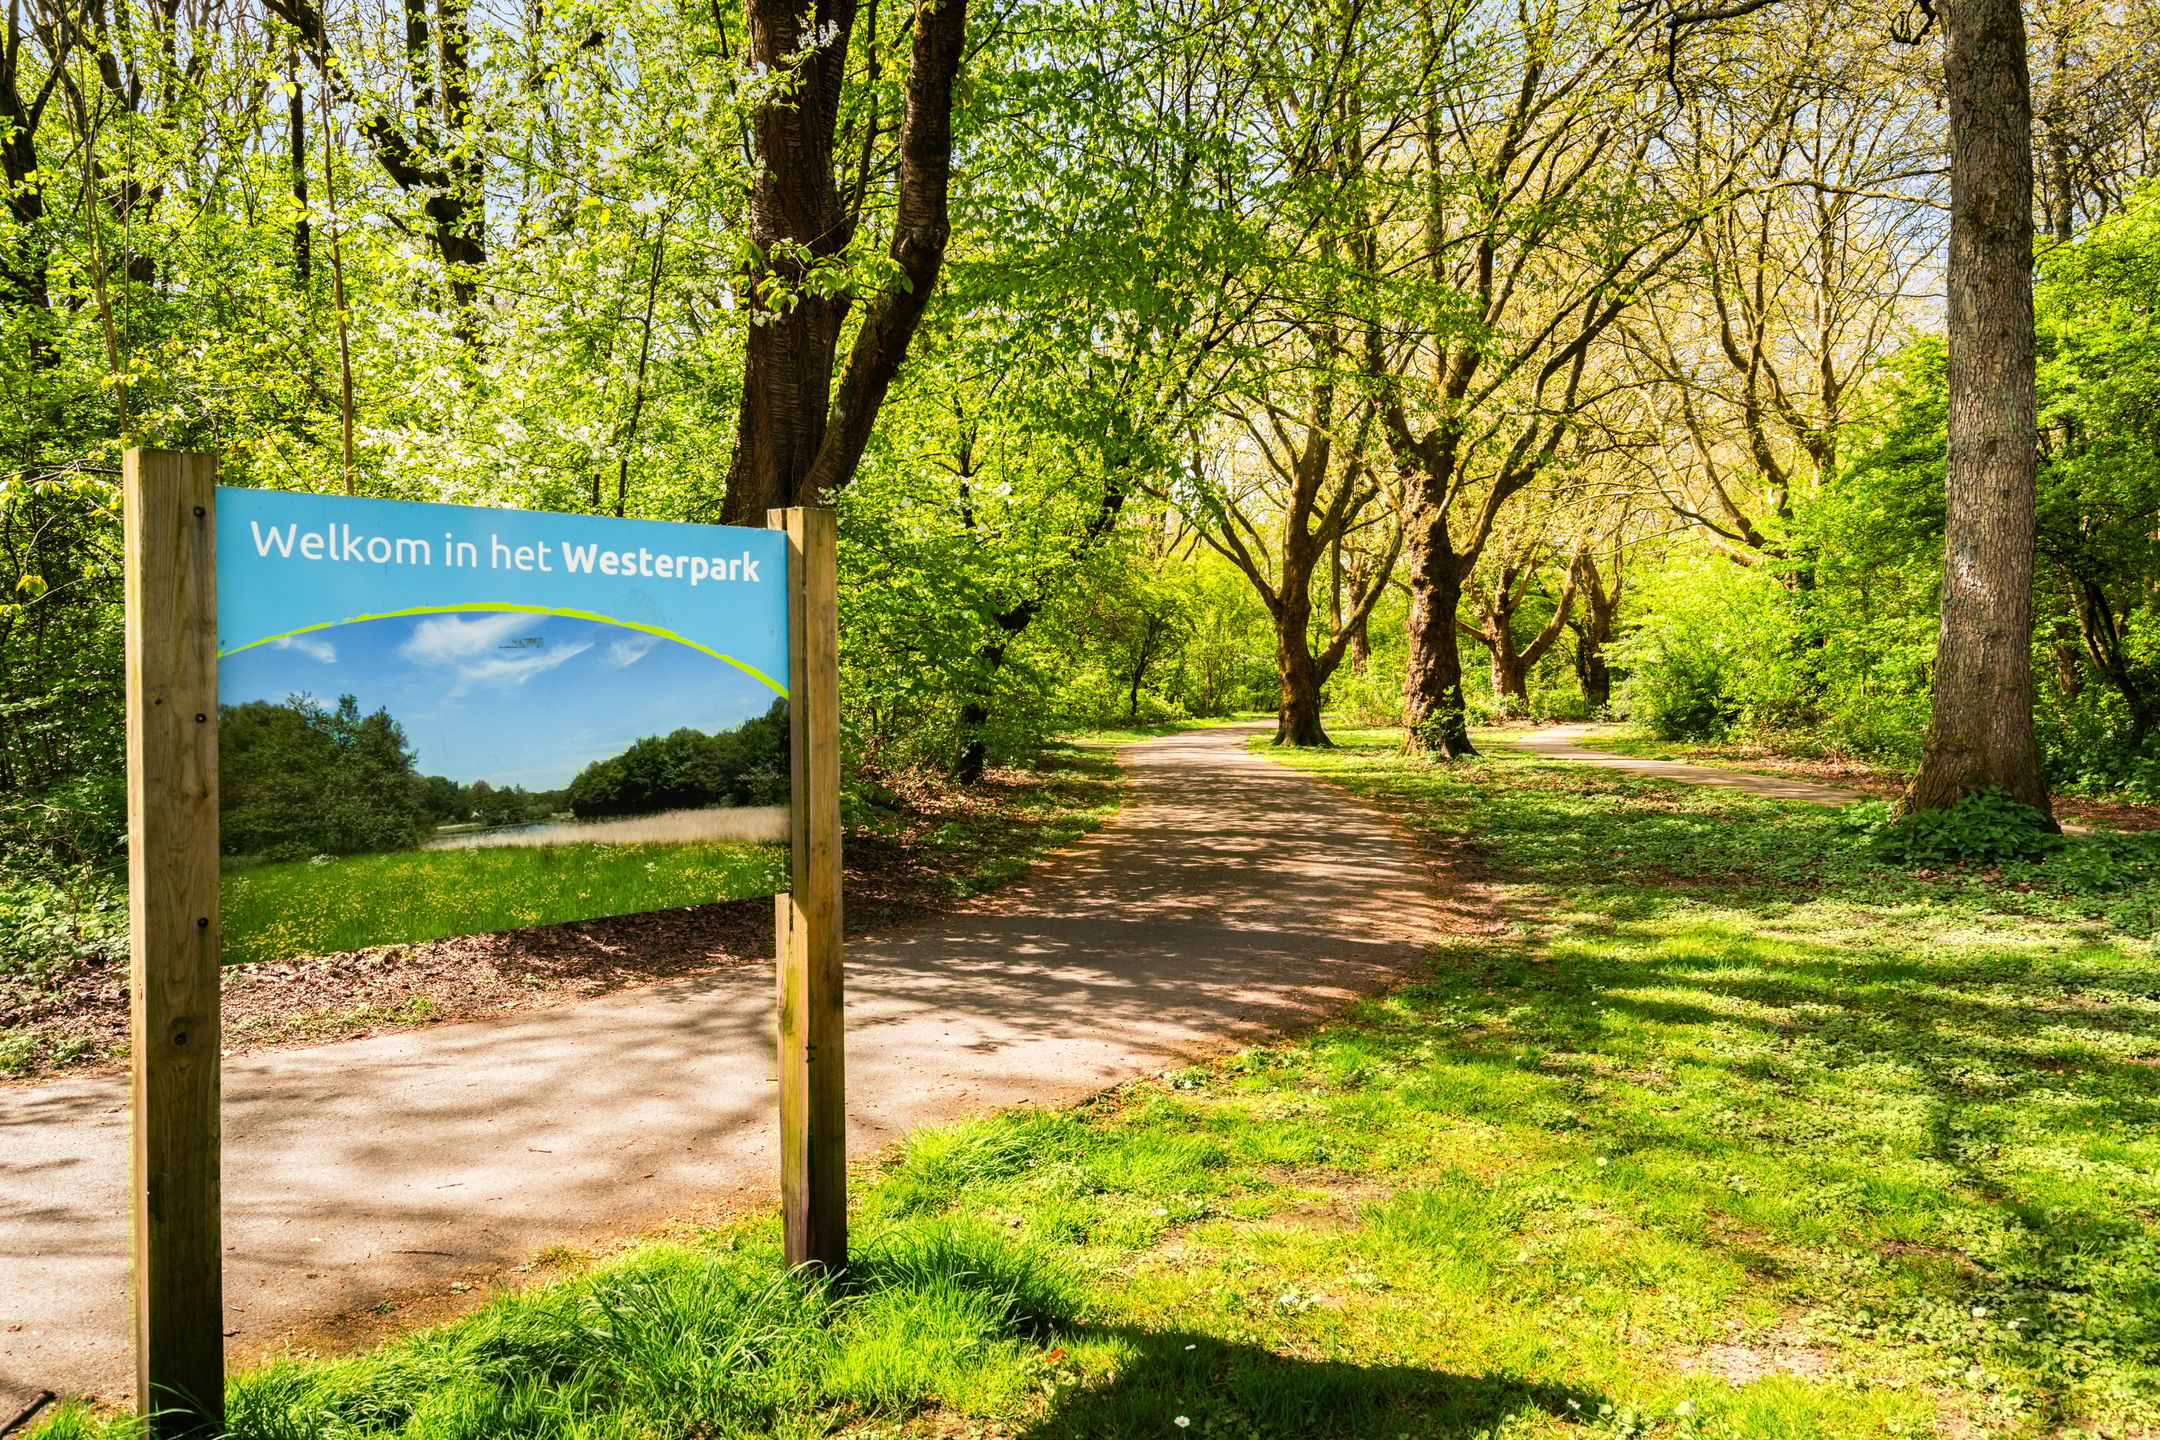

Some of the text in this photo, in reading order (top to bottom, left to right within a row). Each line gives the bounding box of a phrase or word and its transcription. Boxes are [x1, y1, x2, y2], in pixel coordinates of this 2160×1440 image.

[250, 521, 761, 586] Welkom in het Westerpark
